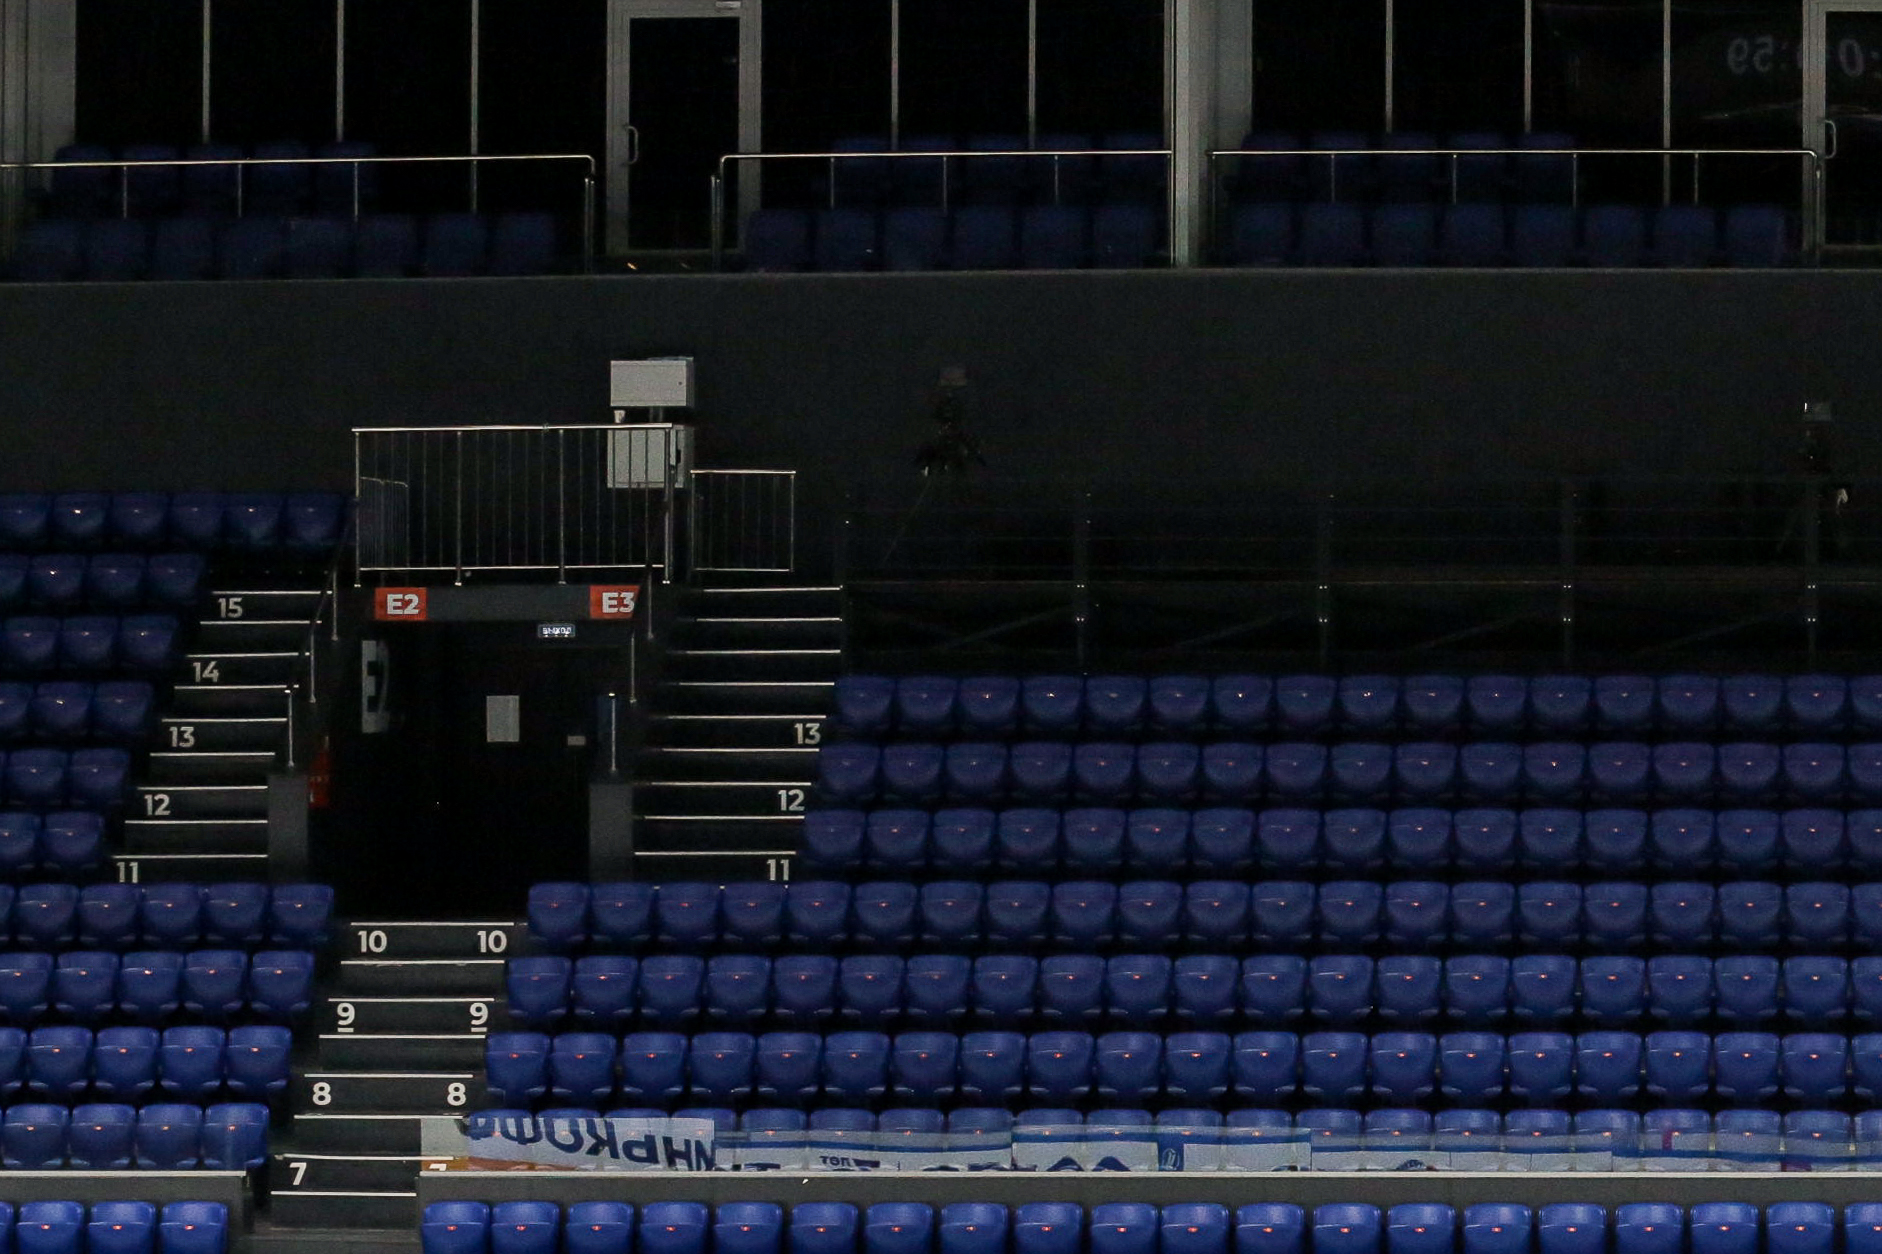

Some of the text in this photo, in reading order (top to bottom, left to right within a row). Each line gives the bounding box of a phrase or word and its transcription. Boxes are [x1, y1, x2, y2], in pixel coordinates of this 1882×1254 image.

[219, 598, 242, 617] 15
[387, 594, 419, 614] E2
[603, 592, 634, 613] E3
[193, 661, 219, 681] 14
[170, 727, 194, 747] 13
[795, 723, 820, 744] 13
[145, 794, 170, 815] 12
[778, 789, 804, 810] 12
[117, 862, 138, 883] 11
[767, 859, 789, 880] 11
[358, 931, 387, 952] 10
[477, 930, 507, 952] 10
[337, 1003, 355, 1026] 9
[469, 1003, 488, 1026] 9
[313, 1082, 331, 1105] 8
[447, 1083, 466, 1106] 8
[290, 1162, 306, 1185] 7
